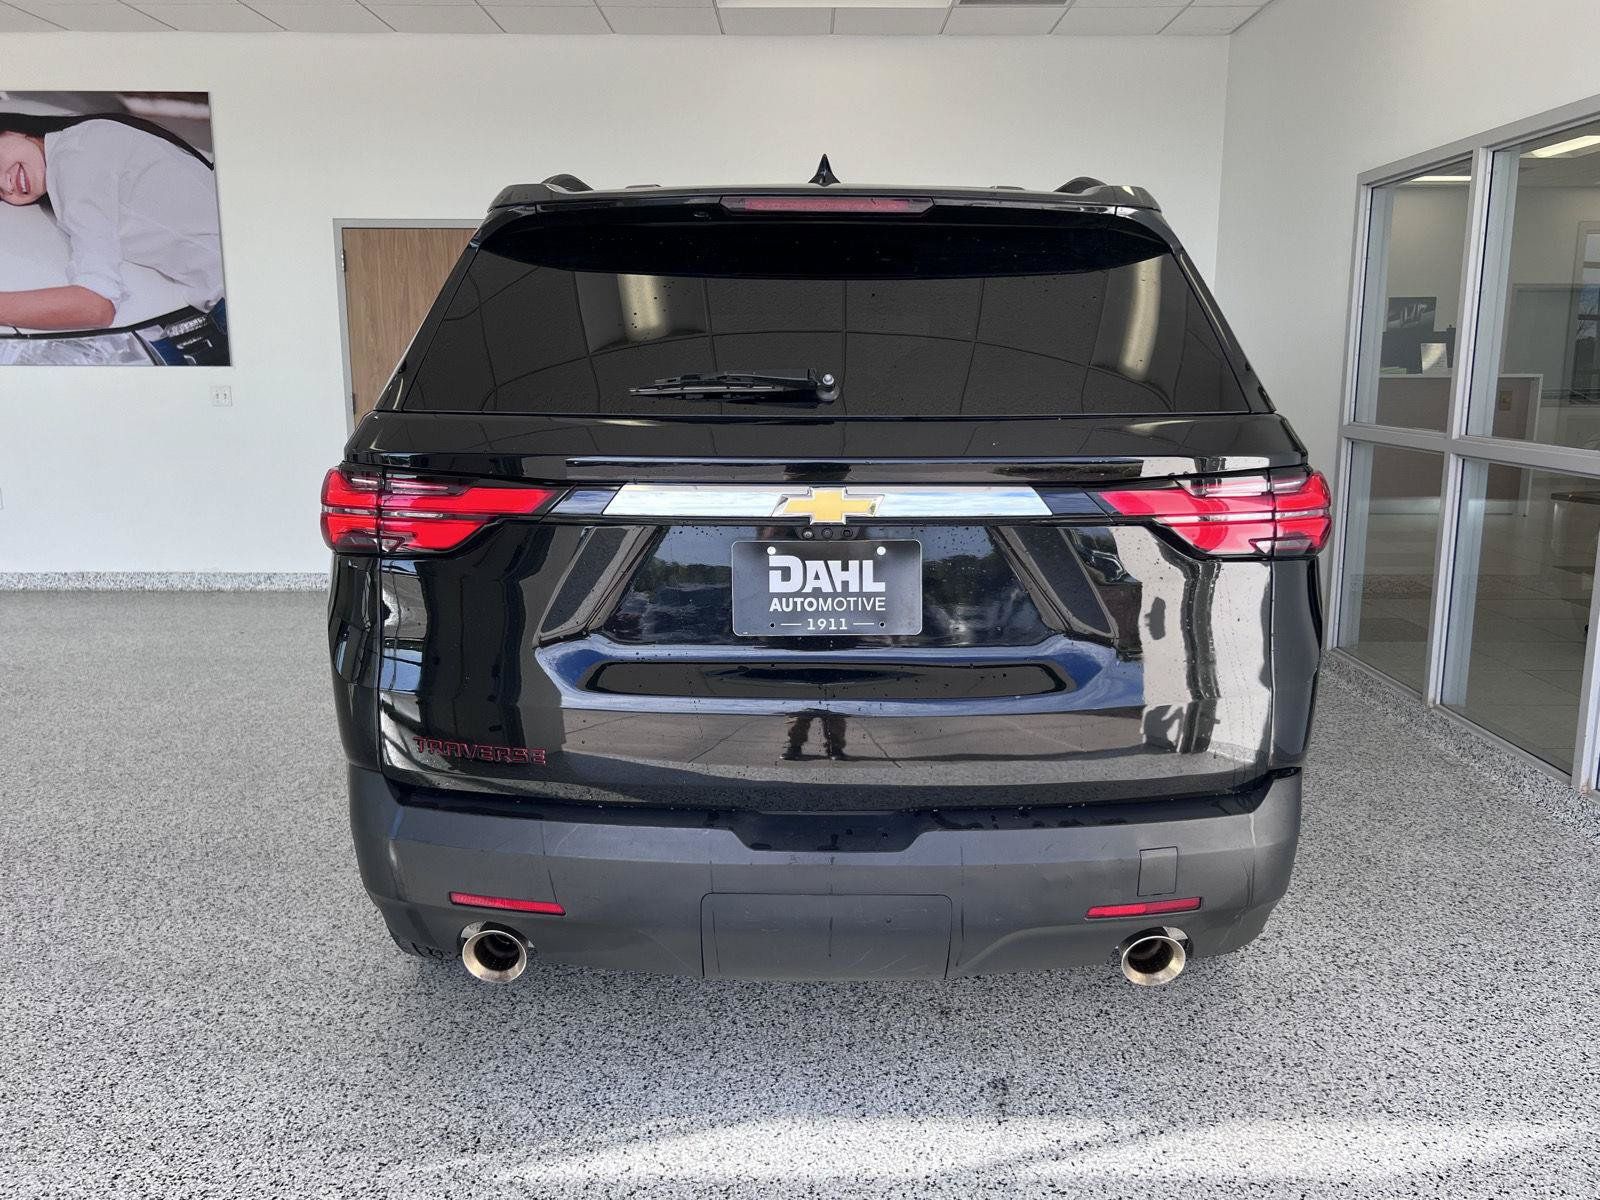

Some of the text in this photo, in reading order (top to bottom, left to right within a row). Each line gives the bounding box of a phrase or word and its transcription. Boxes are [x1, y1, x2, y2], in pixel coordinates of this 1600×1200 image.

[769, 555, 886, 593] DAHL
[769, 597, 886, 612] AUTOMOTIVE
[807, 618, 848, 630] 1911
[413, 736, 546, 766] TRAVERSE
